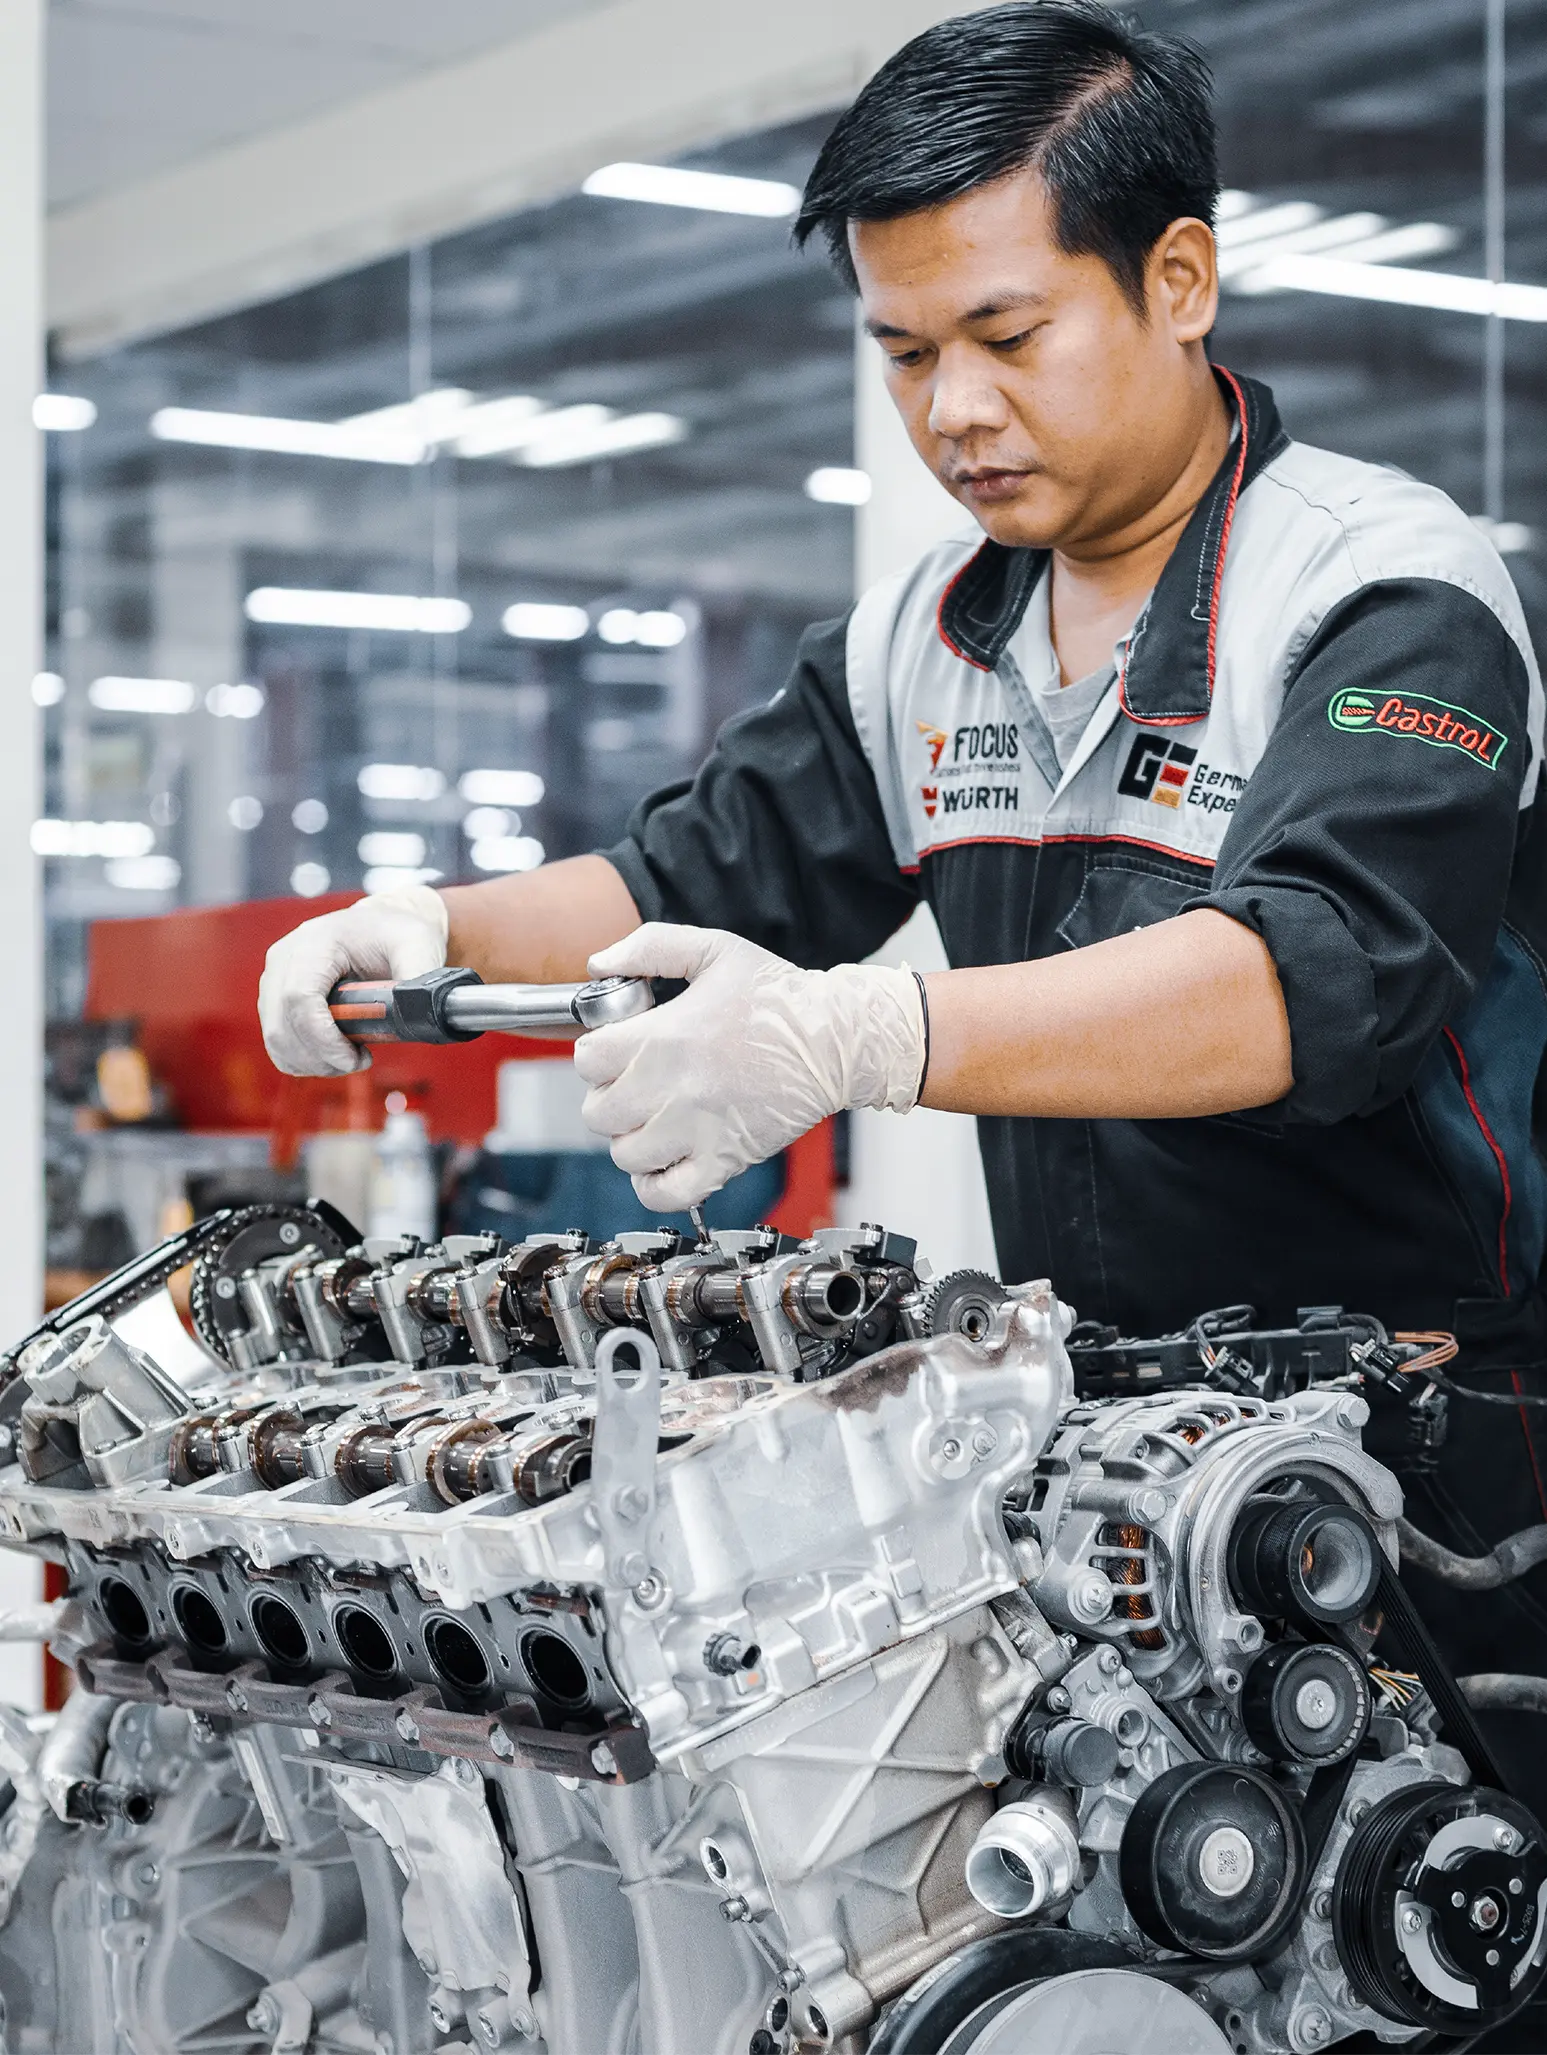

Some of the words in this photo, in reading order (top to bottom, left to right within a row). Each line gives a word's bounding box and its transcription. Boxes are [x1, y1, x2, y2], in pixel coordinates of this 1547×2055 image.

[954, 723, 1019, 762] FOCUS
[1376, 697, 1493, 761] Castrol
[1187, 784, 1237, 813] Expe
